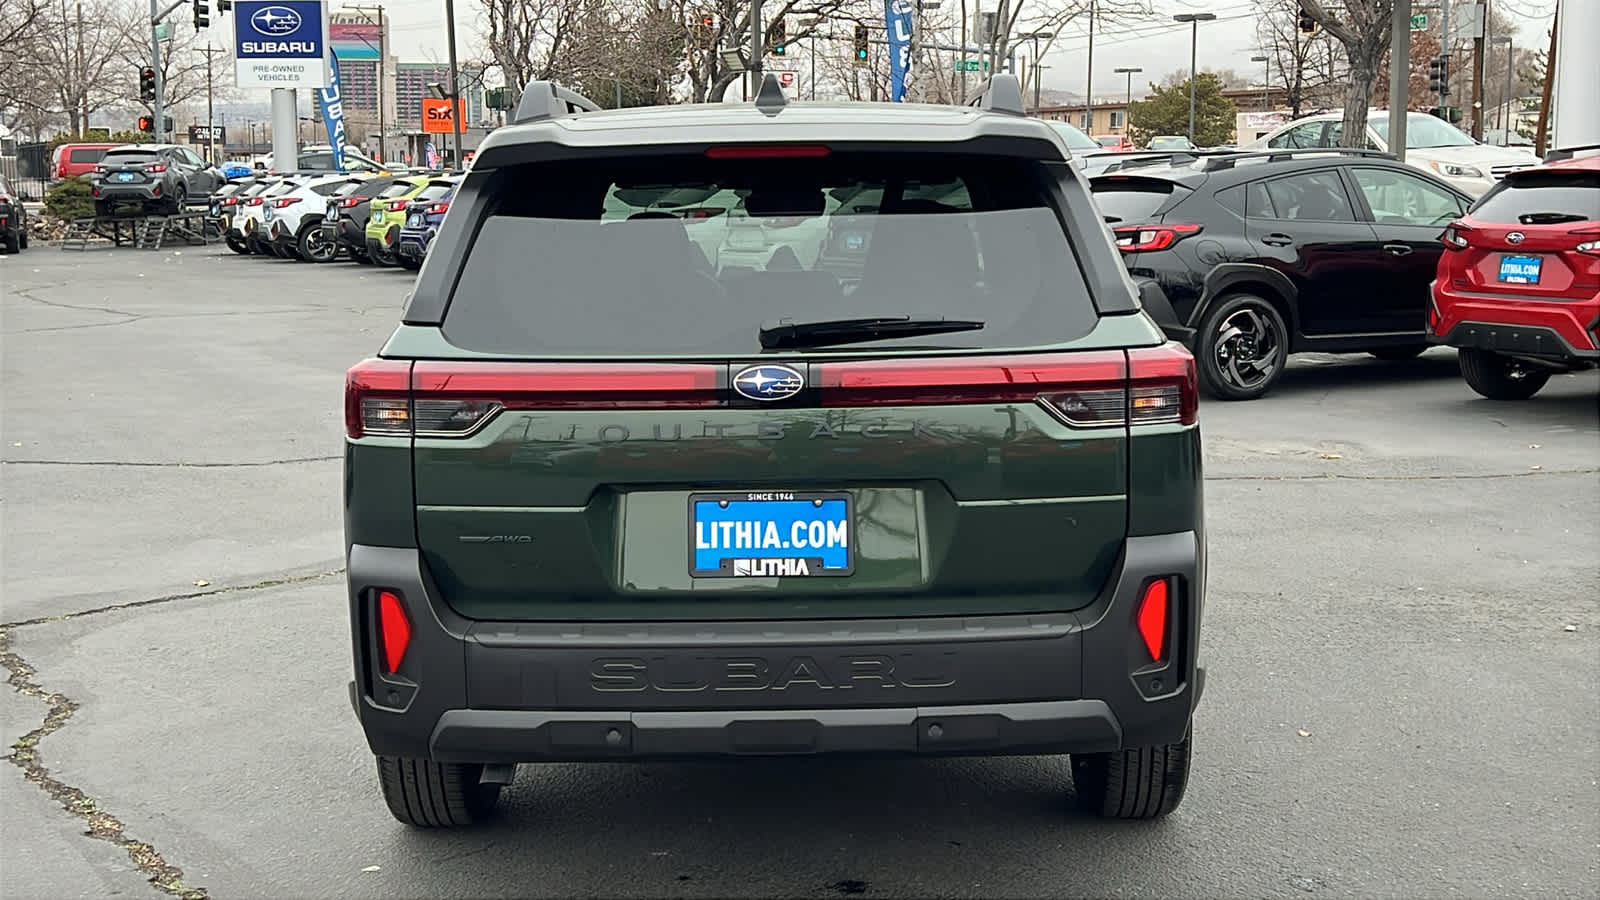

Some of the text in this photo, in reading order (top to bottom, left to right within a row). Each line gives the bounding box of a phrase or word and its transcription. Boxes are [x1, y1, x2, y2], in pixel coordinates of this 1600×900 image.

[242, 41, 315, 53] SUBARU
[253, 65, 305, 73] PRE-OWNED
[1500, 263, 1540, 275] LITHIA.COM
[602, 421, 938, 442] OUTBACK
[747, 493, 794, 501] SINCE 1946
[695, 519, 848, 550] LITHIA.COM
[751, 558, 810, 577] LITHIA
[591, 652, 958, 692] SUBARU
